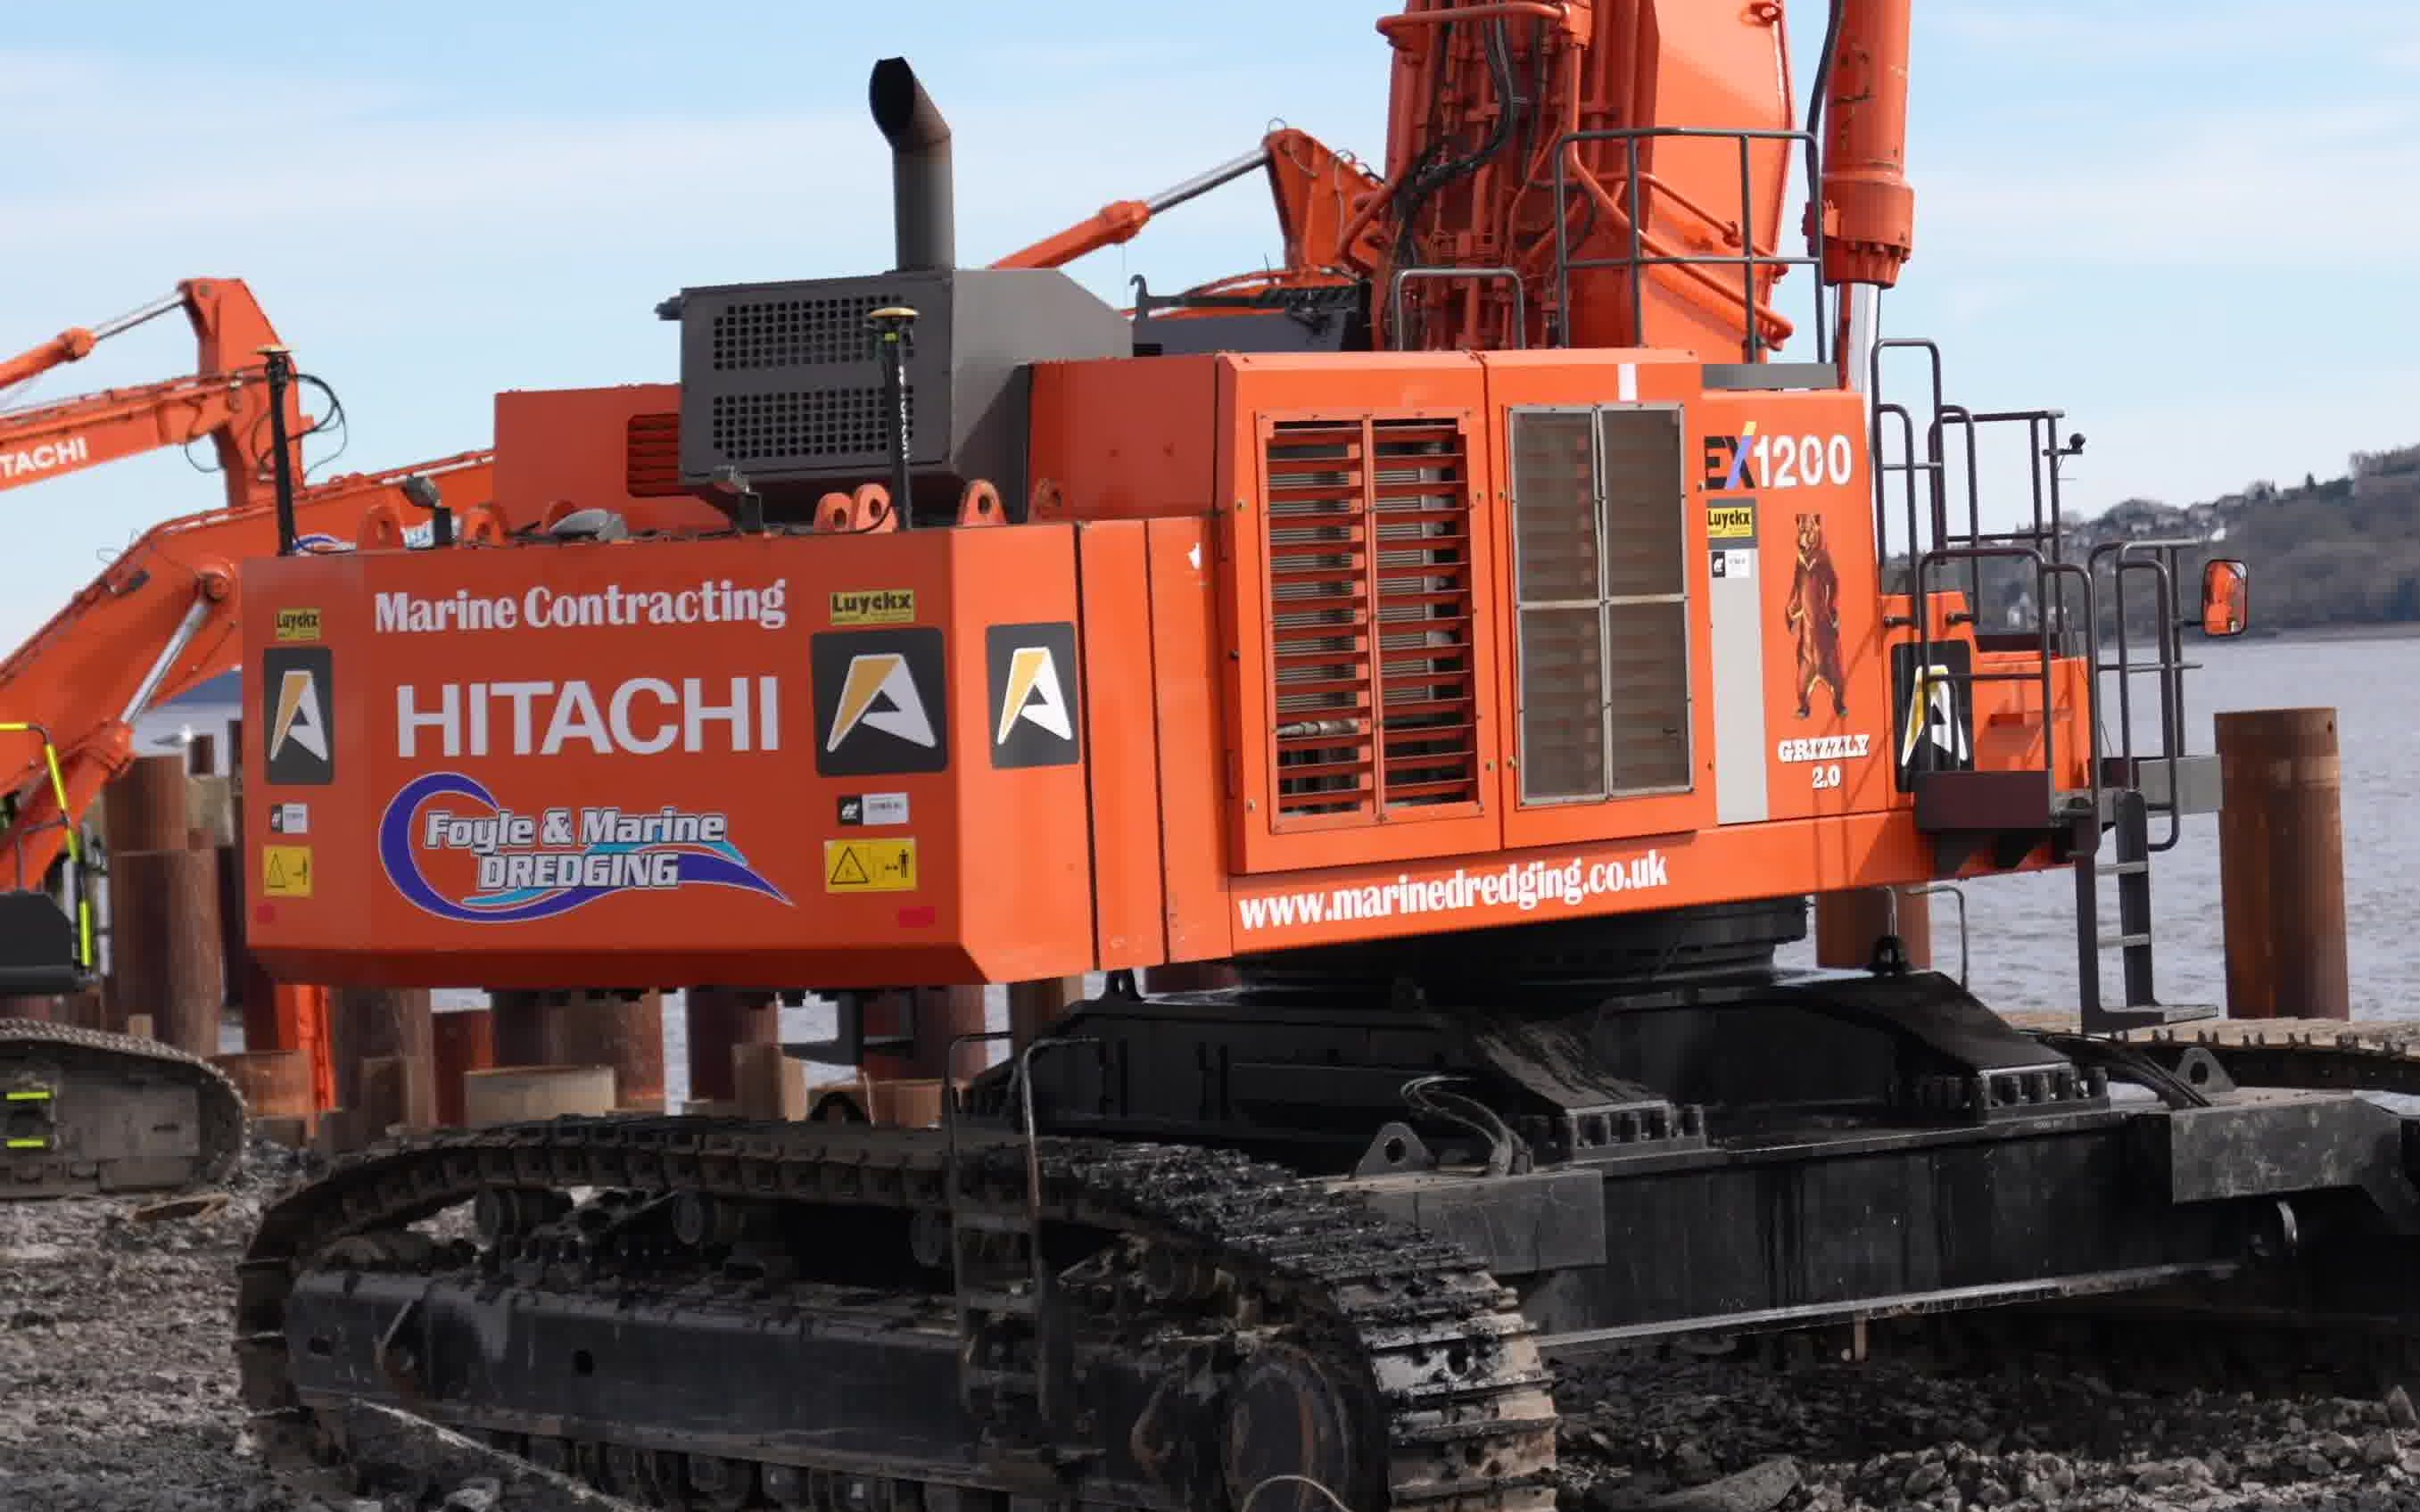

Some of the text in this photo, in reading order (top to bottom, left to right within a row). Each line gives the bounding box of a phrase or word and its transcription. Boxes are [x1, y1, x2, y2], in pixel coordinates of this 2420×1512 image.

[1707, 508, 1750, 529] Luyckx
[375, 578, 787, 633] Marine Contracting
[831, 591, 912, 615] Luyckx
[396, 675, 780, 758] HITACHI
[1777, 734, 1871, 763] GRIZZLY
[1812, 764, 1841, 789] 2.0
[424, 806, 728, 854] Foyle & Marine
[477, 849, 680, 891] DREDGING
[1238, 848, 1668, 930] www.marinedredging.co.uk
